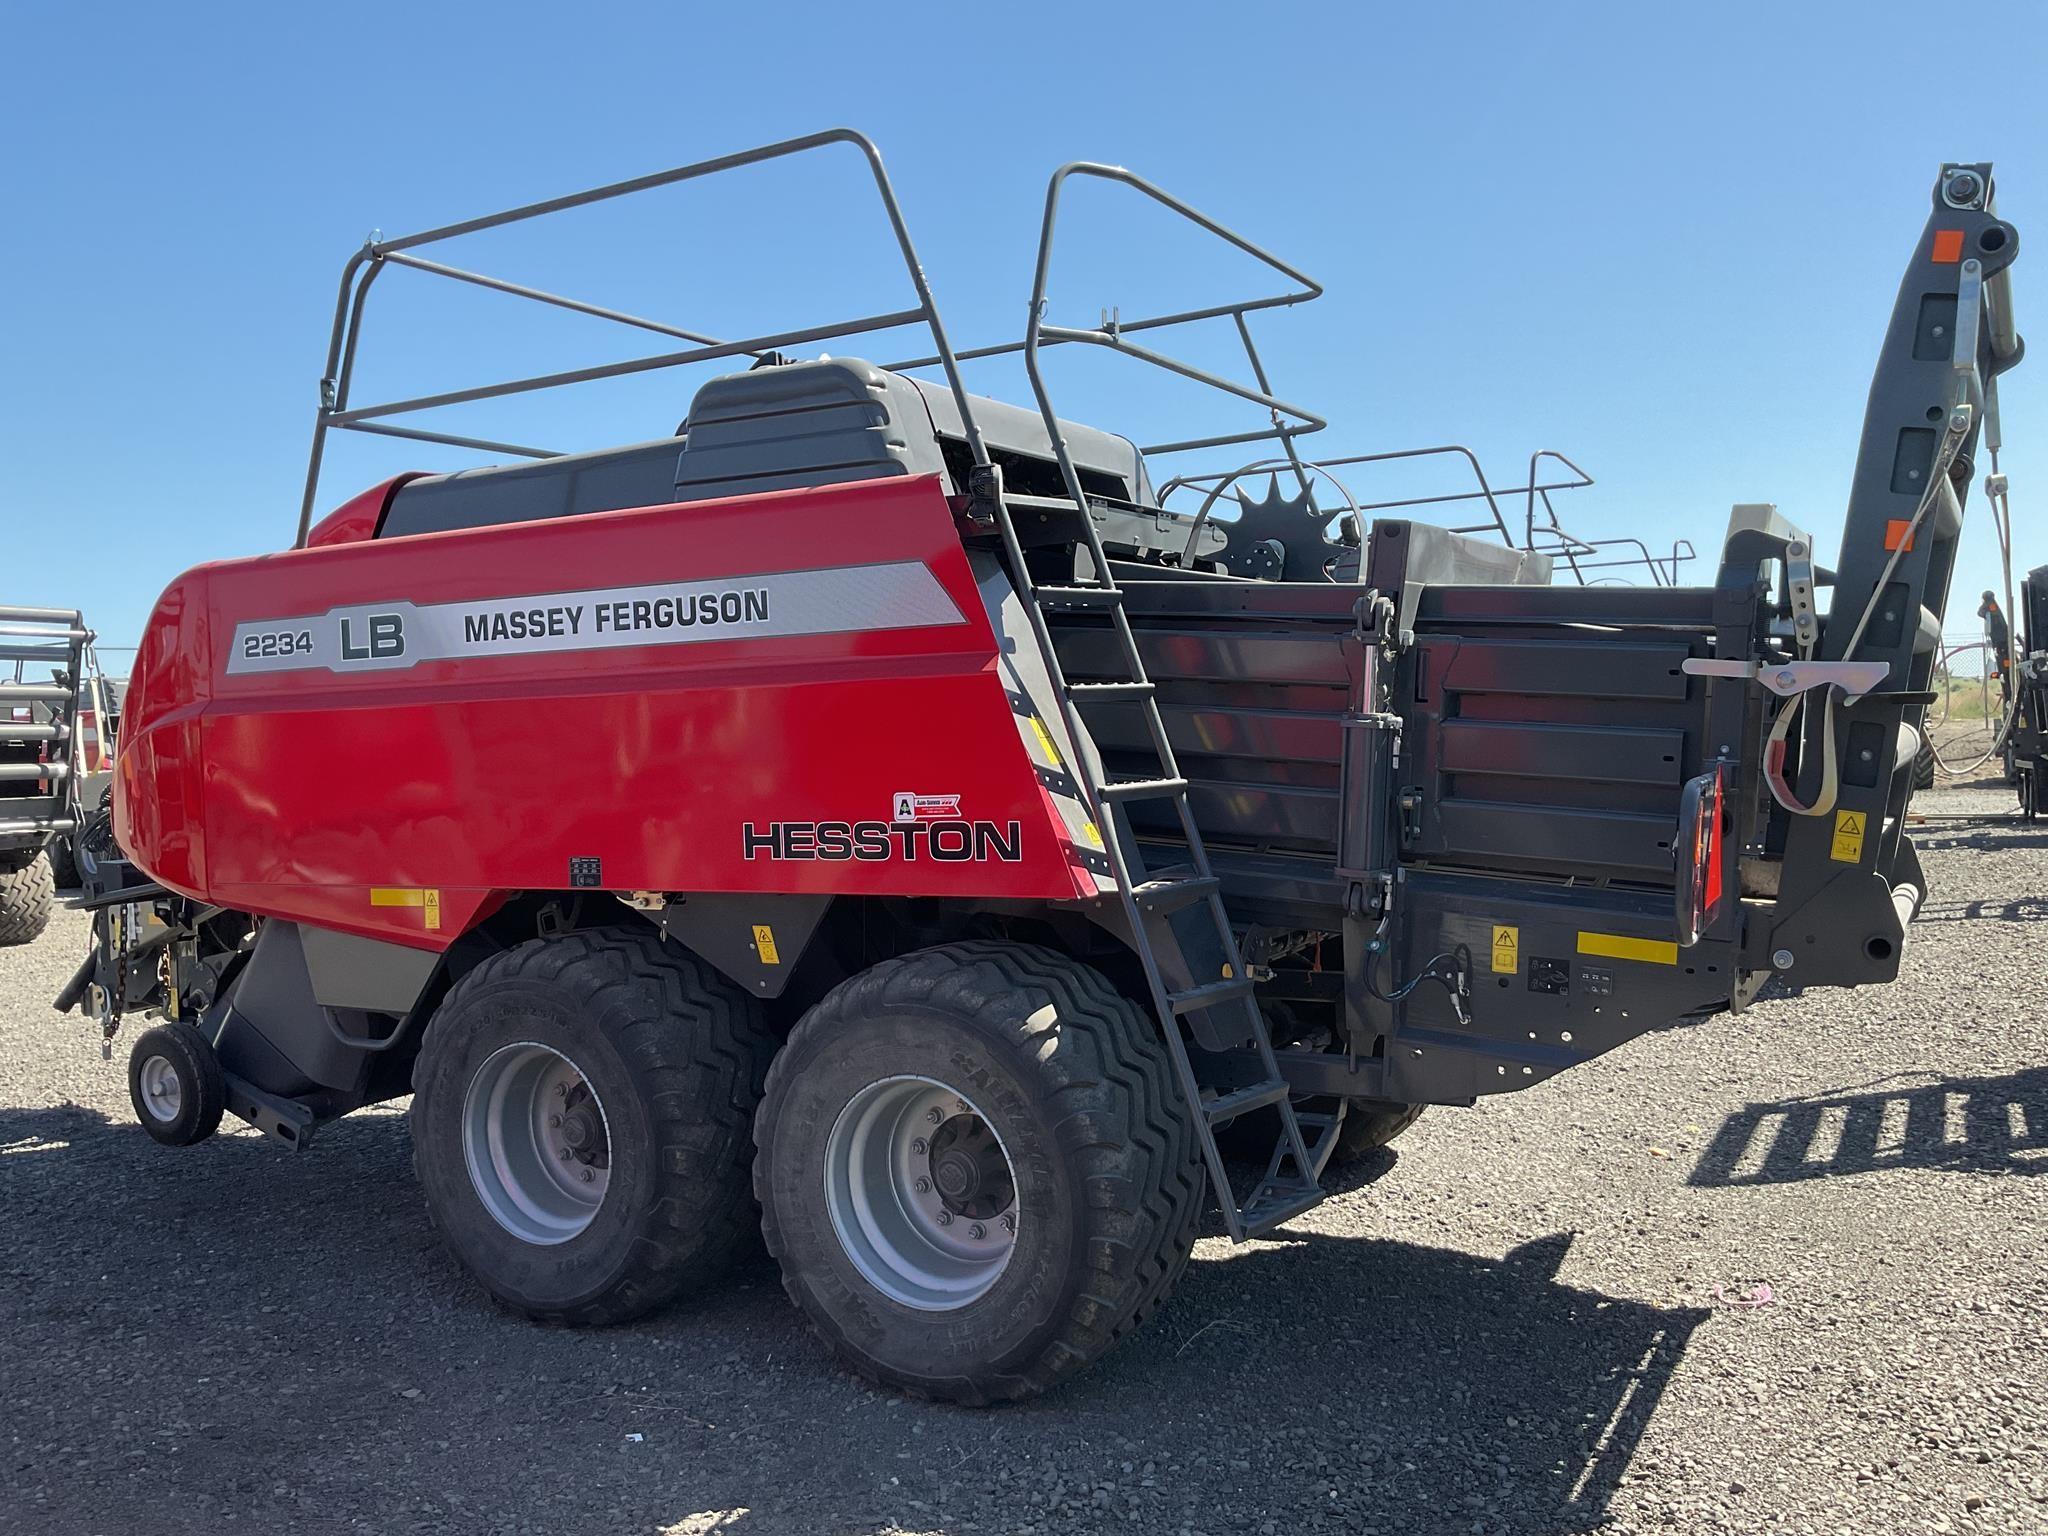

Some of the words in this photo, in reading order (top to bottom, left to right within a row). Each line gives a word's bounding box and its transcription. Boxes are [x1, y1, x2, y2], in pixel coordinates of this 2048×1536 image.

[244, 629, 313, 660] 2234
[340, 614, 406, 661] LB
[464, 604, 584, 643] MASSEY
[594, 588, 770, 633] FERGUSON
[743, 820, 1022, 862] HESSTON
